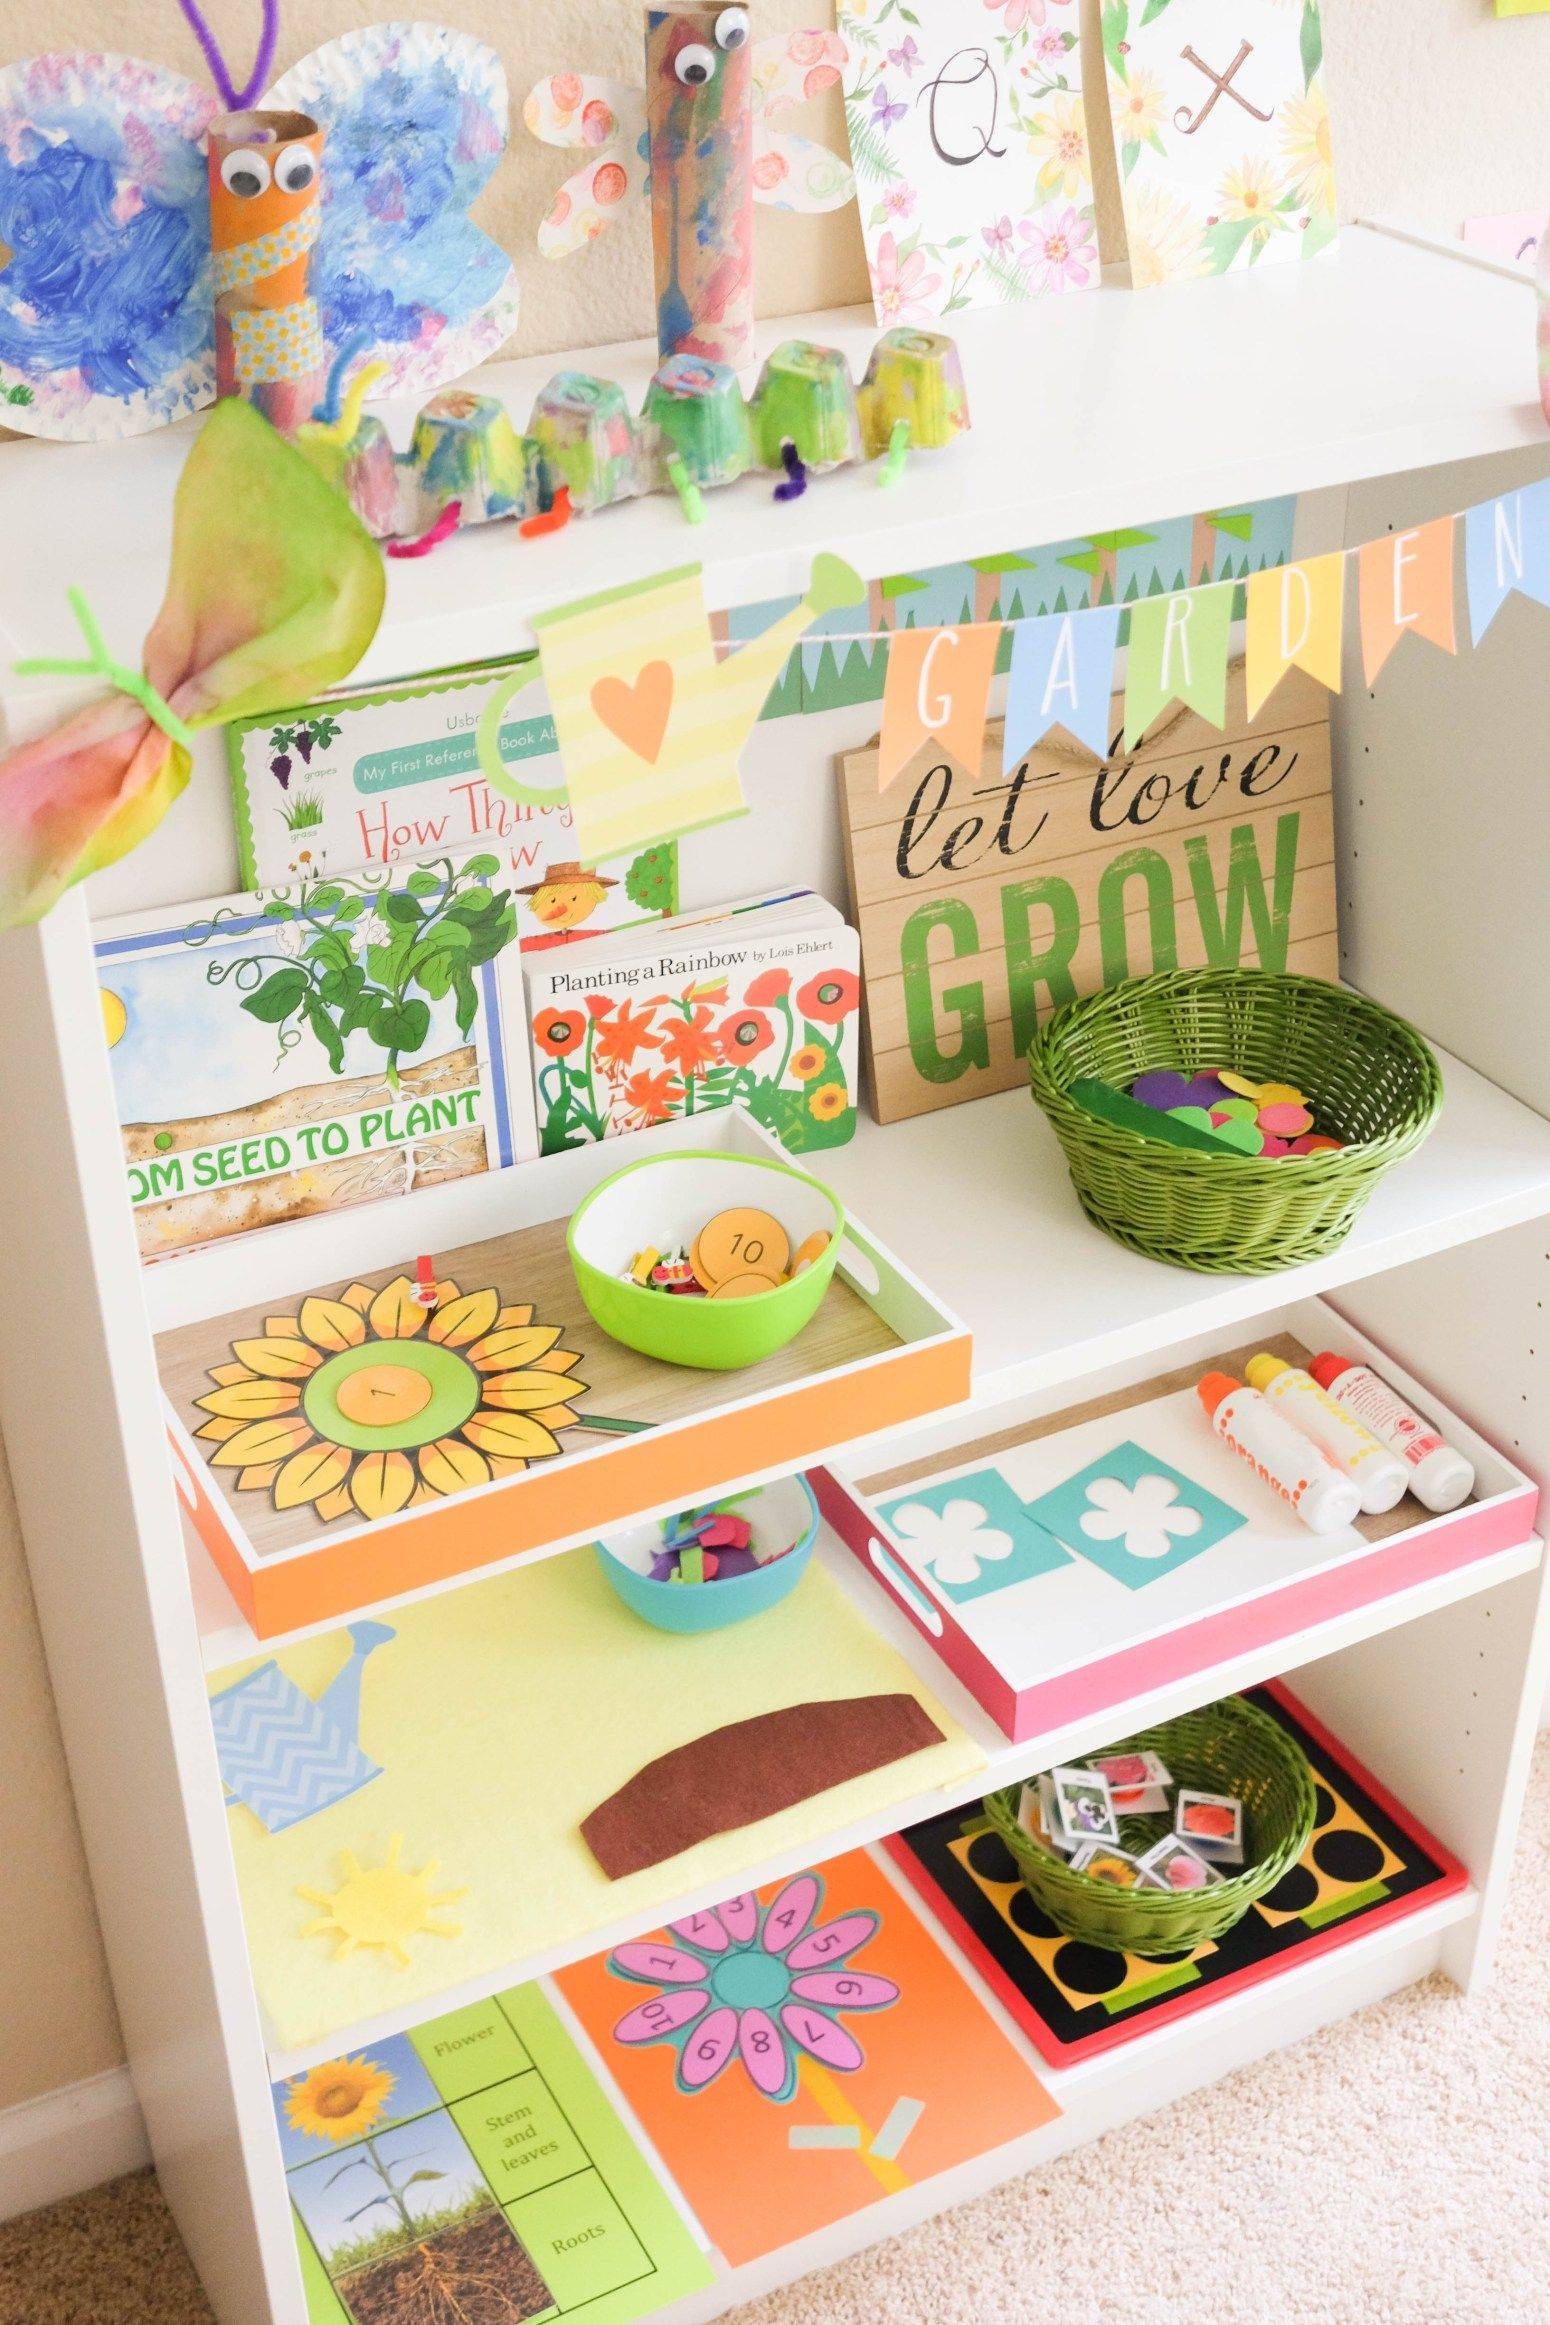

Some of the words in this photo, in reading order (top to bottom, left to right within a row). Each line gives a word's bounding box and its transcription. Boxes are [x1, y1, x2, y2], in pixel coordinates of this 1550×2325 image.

[916, 47, 1007, 166] Q
[363, 766, 387, 781] My
[391, 758, 421, 775] First
[500, 731, 535, 751] Book
[303, 766, 338, 783] grapes
[896, 763, 1060, 880] let
[1089, 727, 1299, 832] love
[356, 800, 451, 863] How
[900, 811, 1301, 1084] GROW
[550, 967, 638, 994] Planting
[643, 965, 654, 979] a
[658, 950, 748, 977] Rainbow
[753, 950, 767, 962] by
[769, 947, 795, 959] Lois
[796, 941, 833, 955] Ehlert
[127, 1159, 184, 1203] OM
[192, 1135, 291, 1188] SEED
[296, 1122, 349, 1162] TO
[360, 1090, 481, 1148] PLANT
[730, 1233, 764, 1264] 10
[775, 1908, 796, 1929] 4
[812, 1933, 841, 1953] 5
[649, 1956, 676, 1971] 1
[640, 2002, 675, 2031] 10
[804, 2020, 825, 2044] 7
[434, 2024, 495, 2058] Flower
[751, 2030, 770, 2053] 8
[486, 2104, 532, 2132] Stem
[503, 2124, 537, 2149] and
[500, 2139, 560, 2172] leaves
[551, 2222, 606, 2255] Roots
